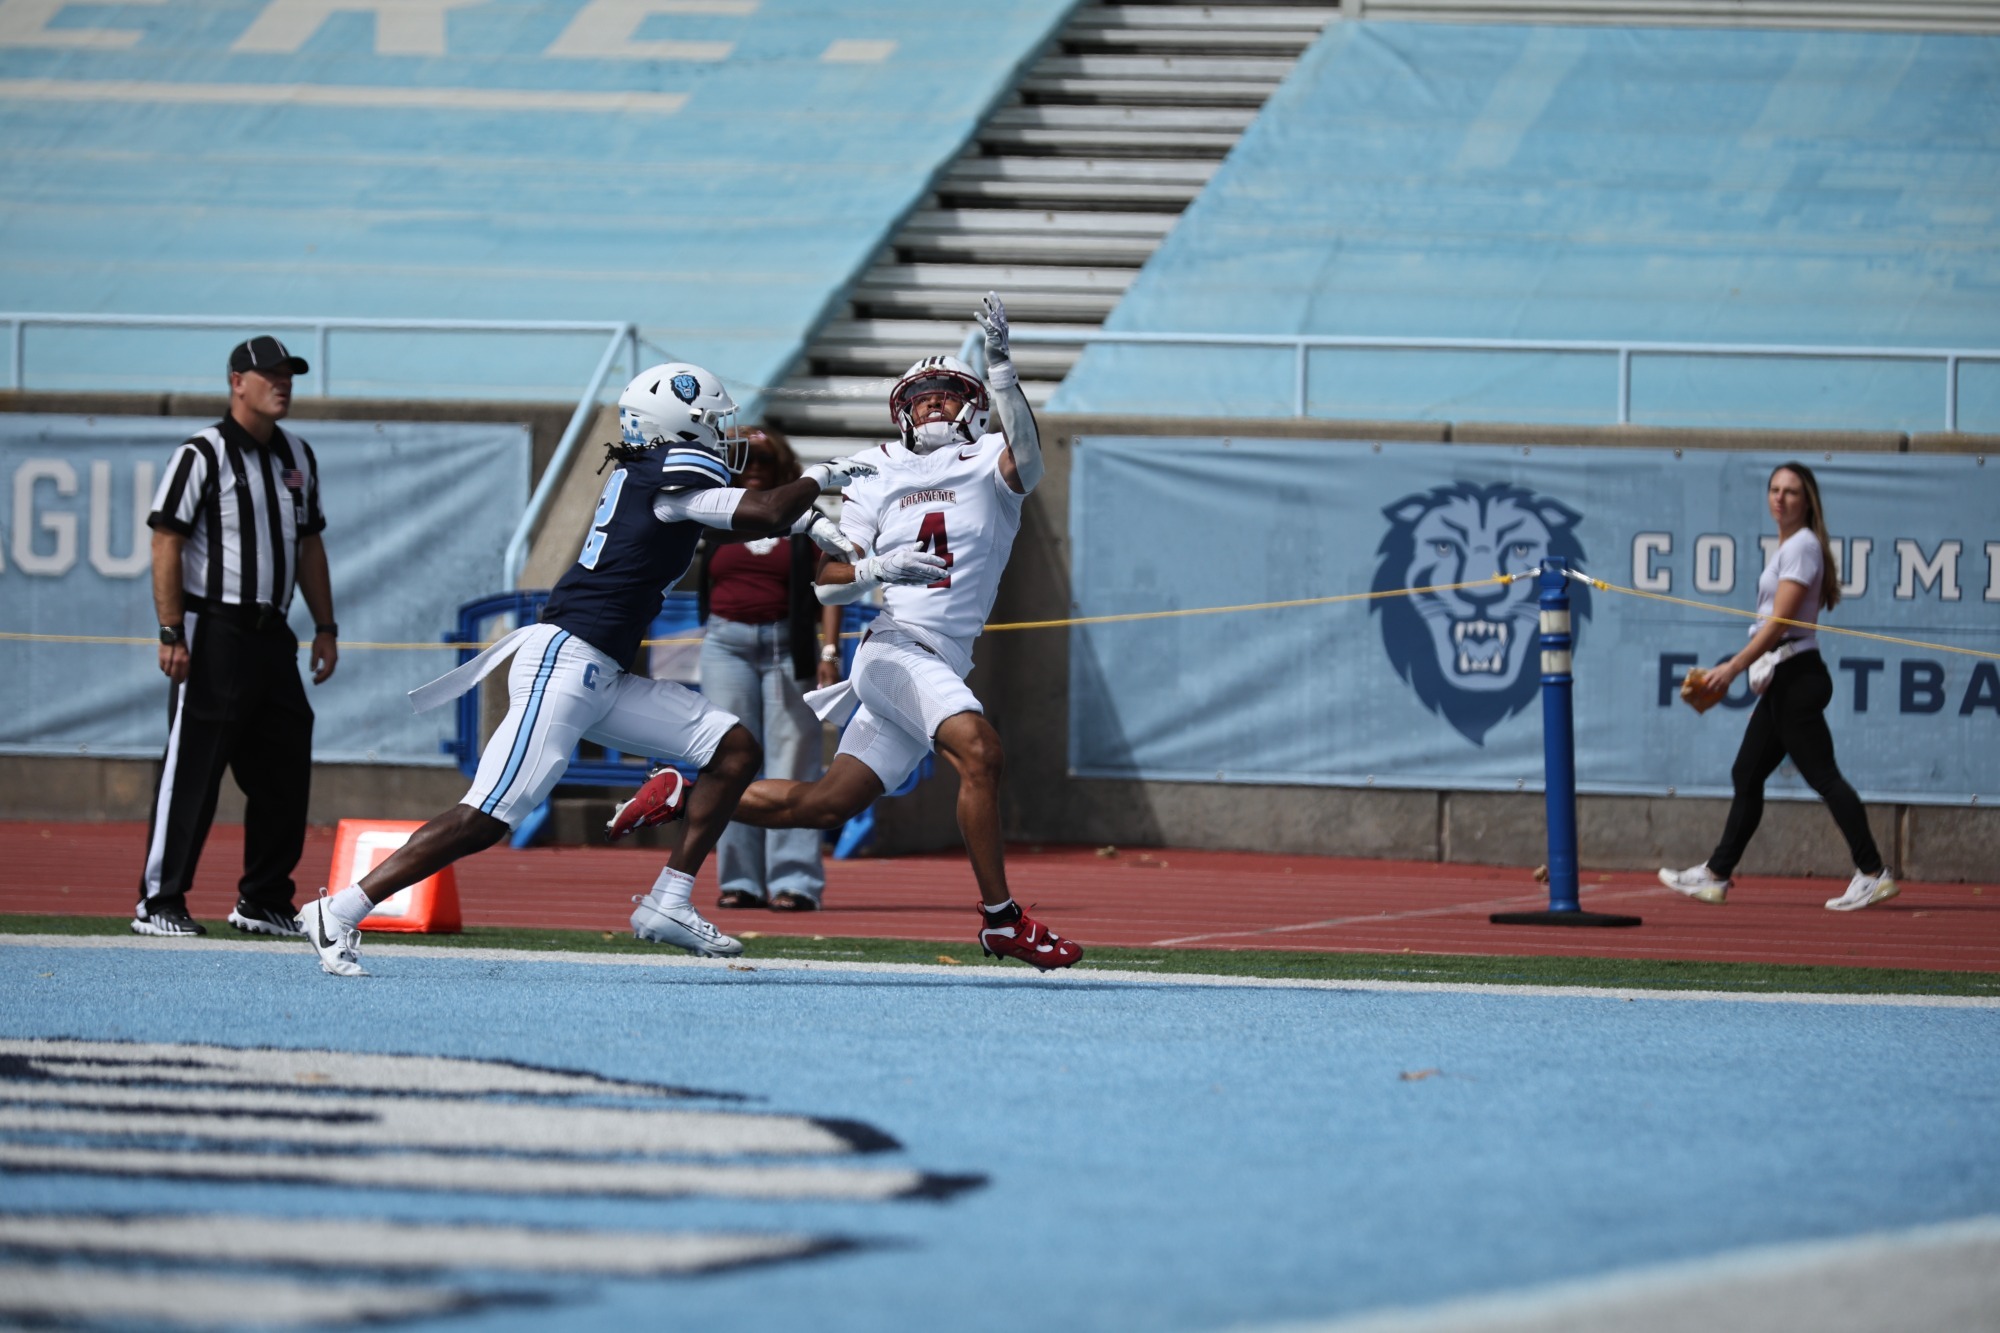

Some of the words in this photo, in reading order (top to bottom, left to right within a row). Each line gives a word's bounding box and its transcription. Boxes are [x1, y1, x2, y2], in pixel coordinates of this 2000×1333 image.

[0, 457, 155, 577] GU
[900, 489, 956, 511] LAFAYETTE
[916, 512, 953, 588] 4
[582, 662, 600, 692] C
